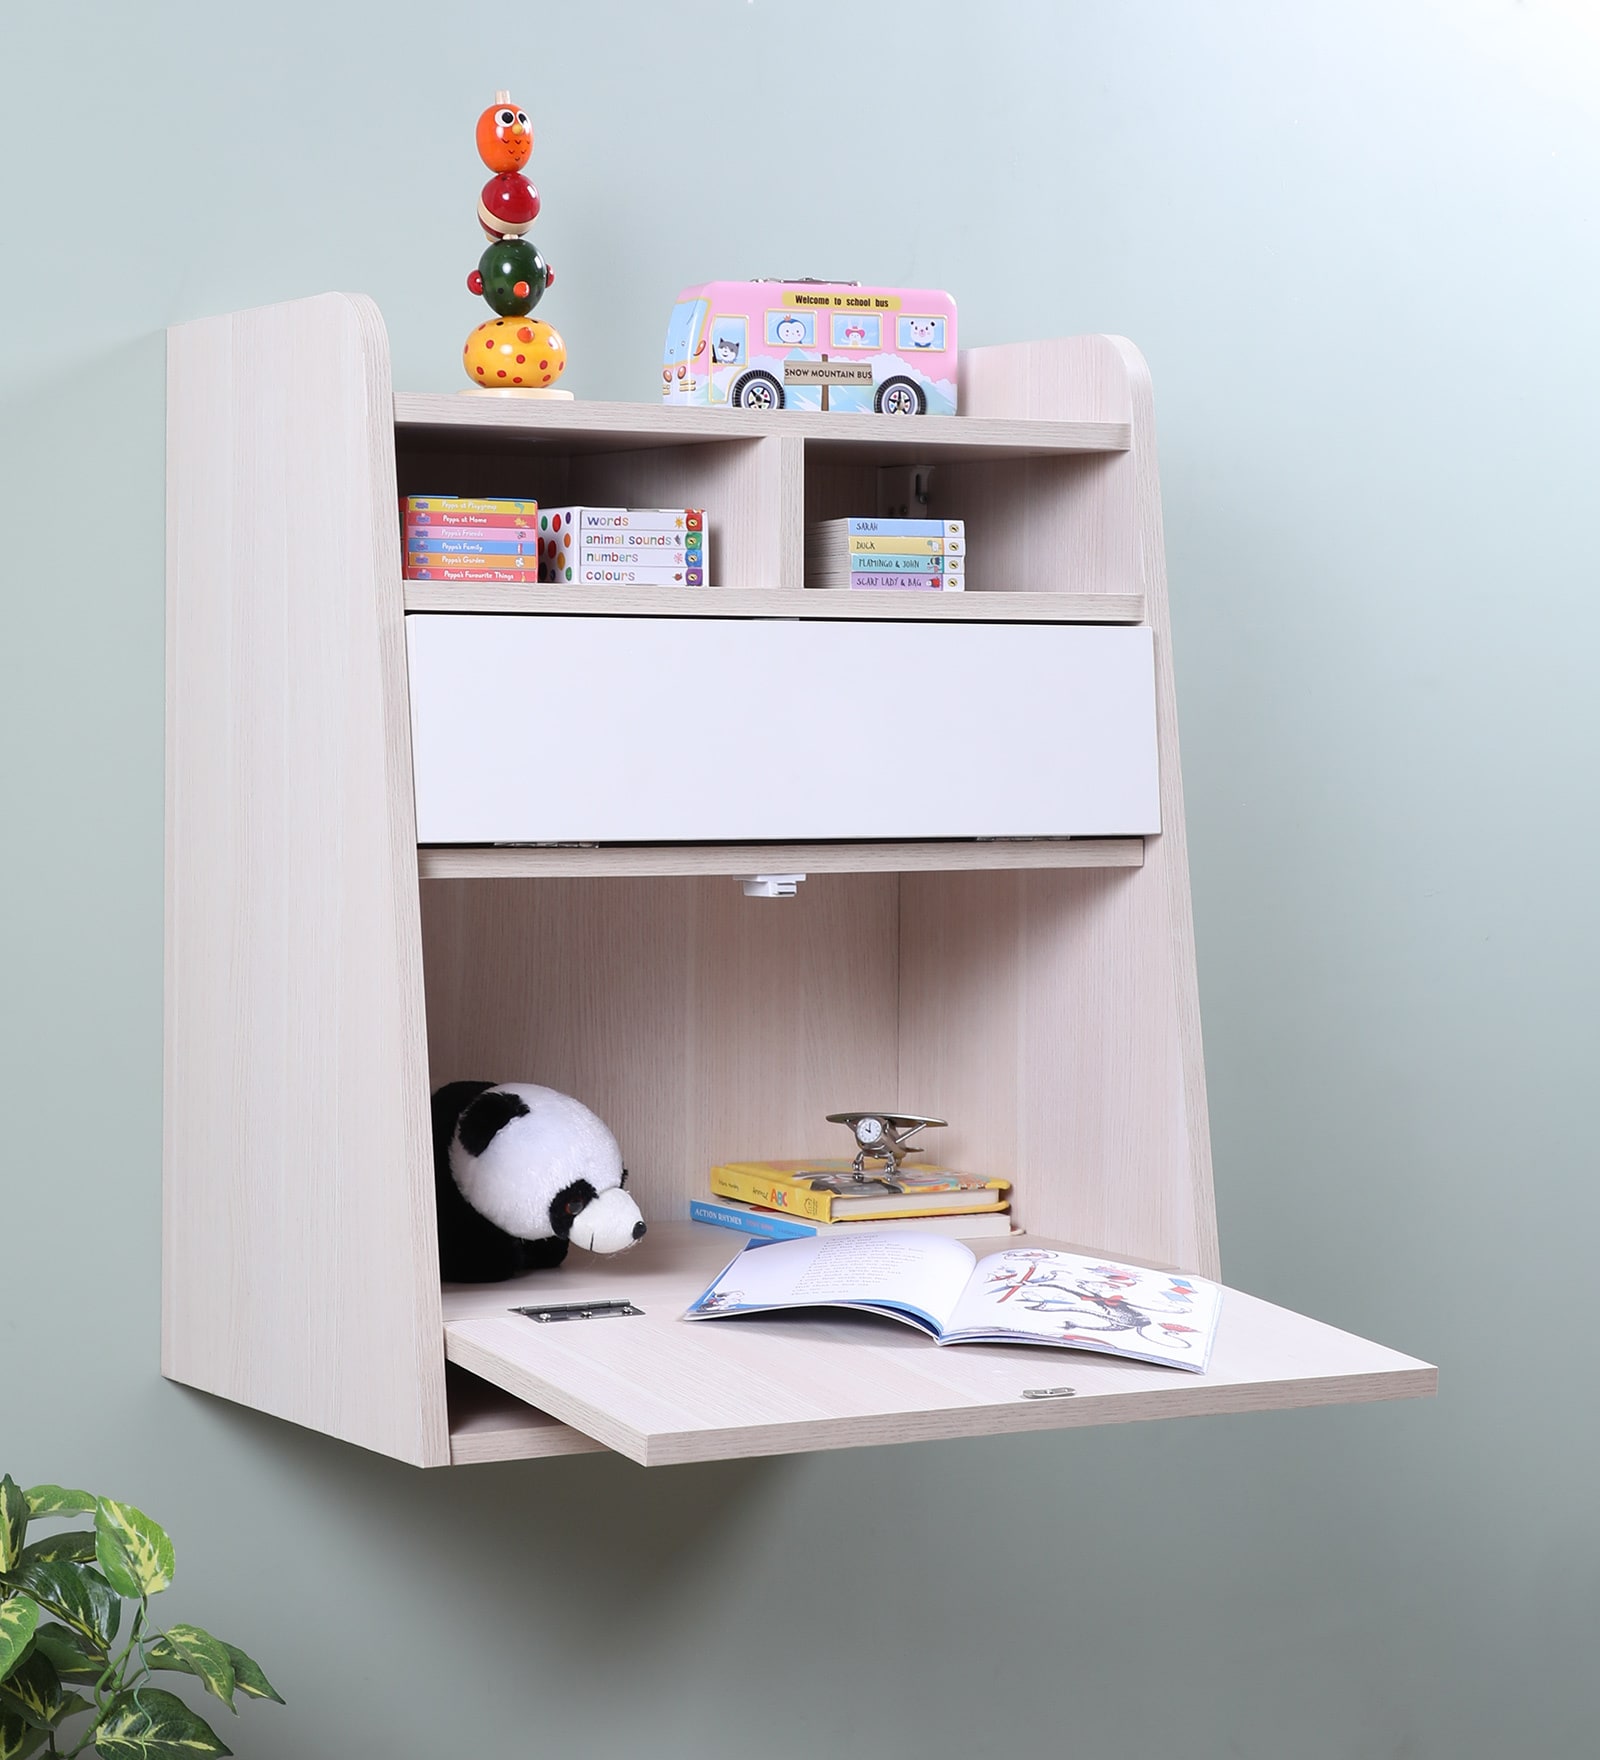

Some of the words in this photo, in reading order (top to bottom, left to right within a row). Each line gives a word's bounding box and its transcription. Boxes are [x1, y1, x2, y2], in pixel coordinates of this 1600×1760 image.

[795, 294, 830, 305] Welcome
[834, 297, 842, 305] to
[846, 298, 871, 306] school
[875, 298, 889, 307] bus
[784, 368, 809, 377] SNOW
[810, 369, 855, 378] MOUNTAIN
[857, 370, 872, 379] BUS
[442, 514, 460, 524] Peppa
[469, 515, 487, 524] Home
[587, 516, 629, 526] words
[855, 522, 878, 531] SARAH
[586, 534, 624, 545] animal
[628, 535, 672, 546] sounds
[462, 543, 483, 552] Family
[856, 541, 876, 550] DUCK
[462, 556, 485, 564] Garden
[586, 552, 639, 562] numbers
[858, 558, 893, 568] FLAMINGO
[895, 560, 901, 568] &
[902, 559, 920, 568] JOHN
[494, 571, 514, 580] Things
[586, 570, 636, 581] colours
[856, 577, 878, 587] SCARF
[881, 578, 899, 587] LADY
[908, 578, 922, 587] BAG
[770, 1188, 788, 1207] ABC
[694, 1208, 718, 1219] ACTION
[717, 1213, 742, 1225] RHYMES
